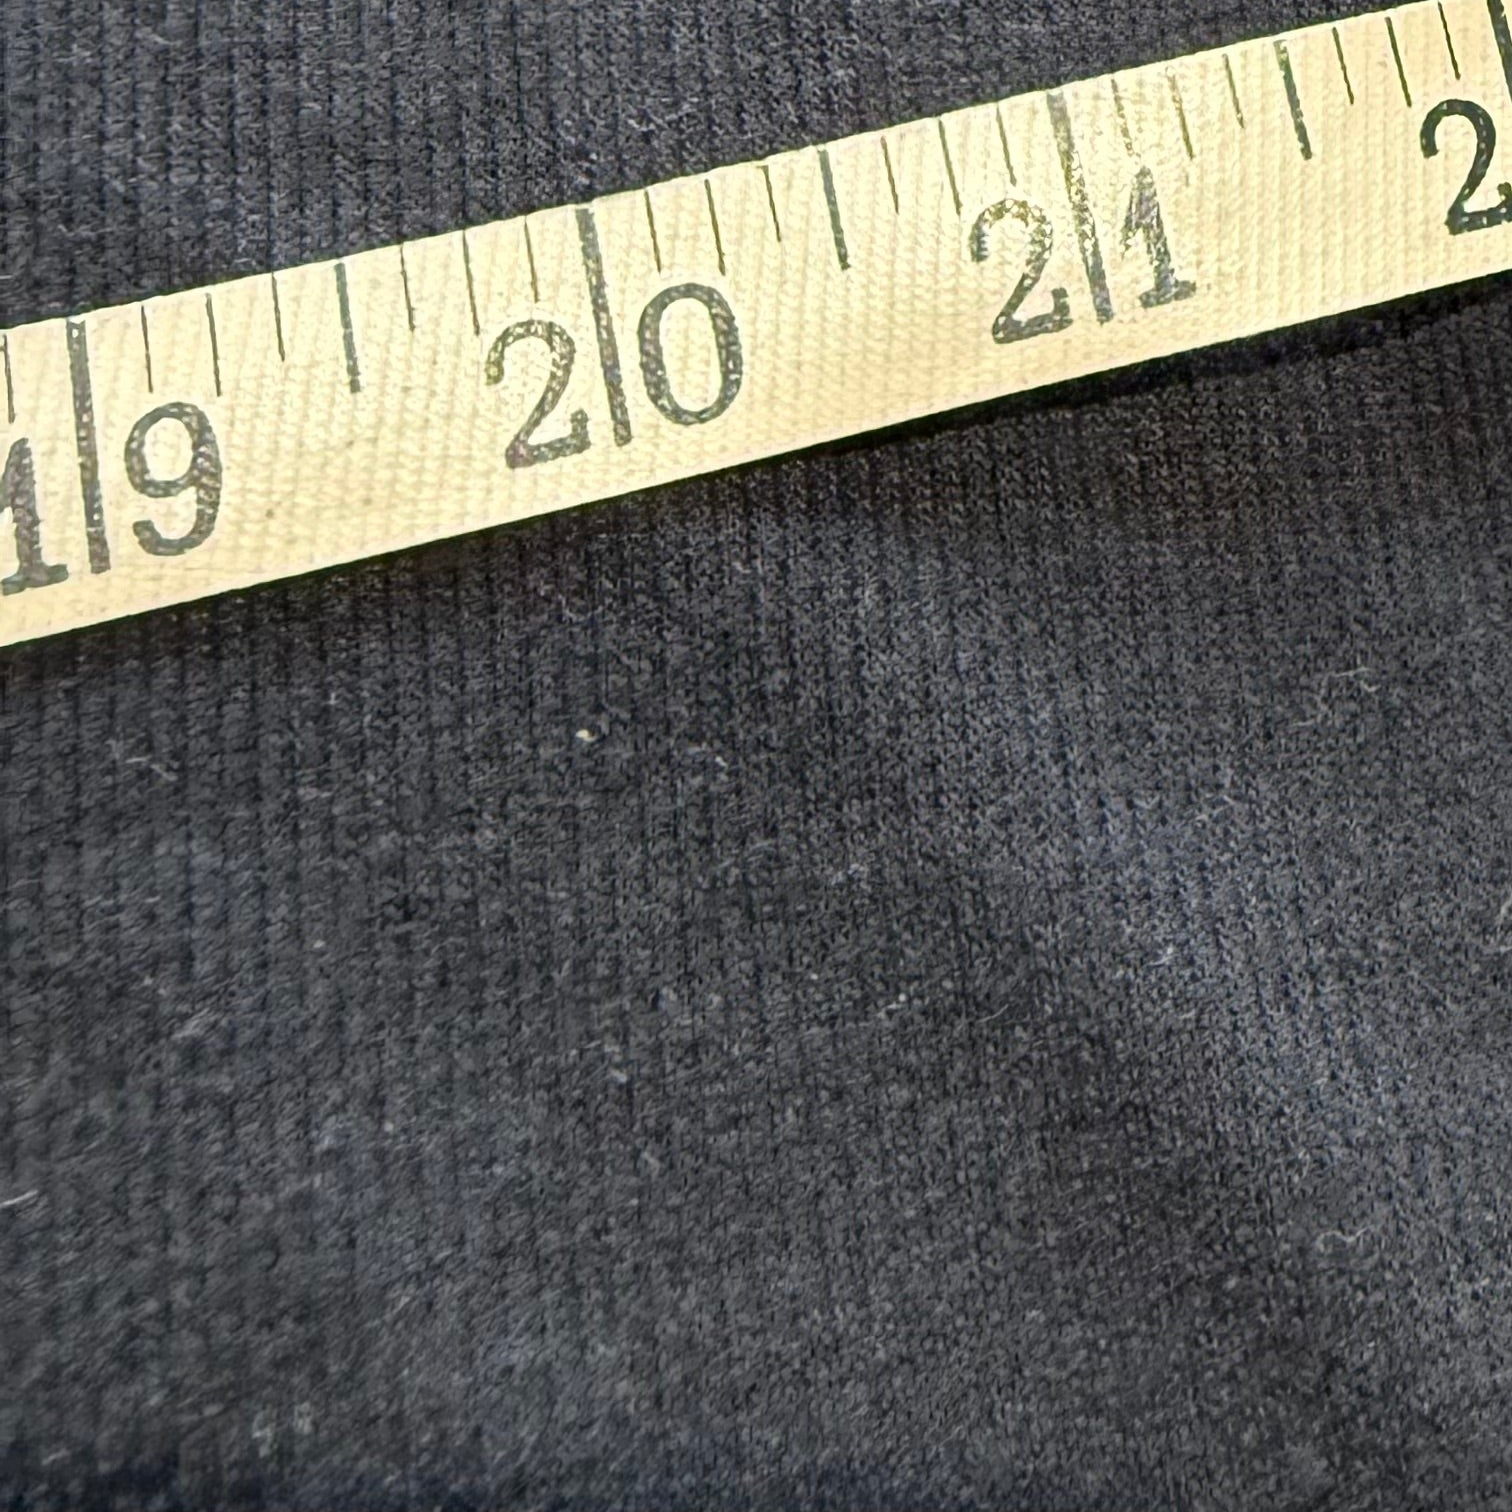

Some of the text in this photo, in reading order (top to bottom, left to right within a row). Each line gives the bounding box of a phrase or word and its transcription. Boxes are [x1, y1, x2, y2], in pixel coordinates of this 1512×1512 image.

[0, 401, 223, 597] 19
[484, 281, 743, 470] 20
[969, 165, 1197, 345] 21
